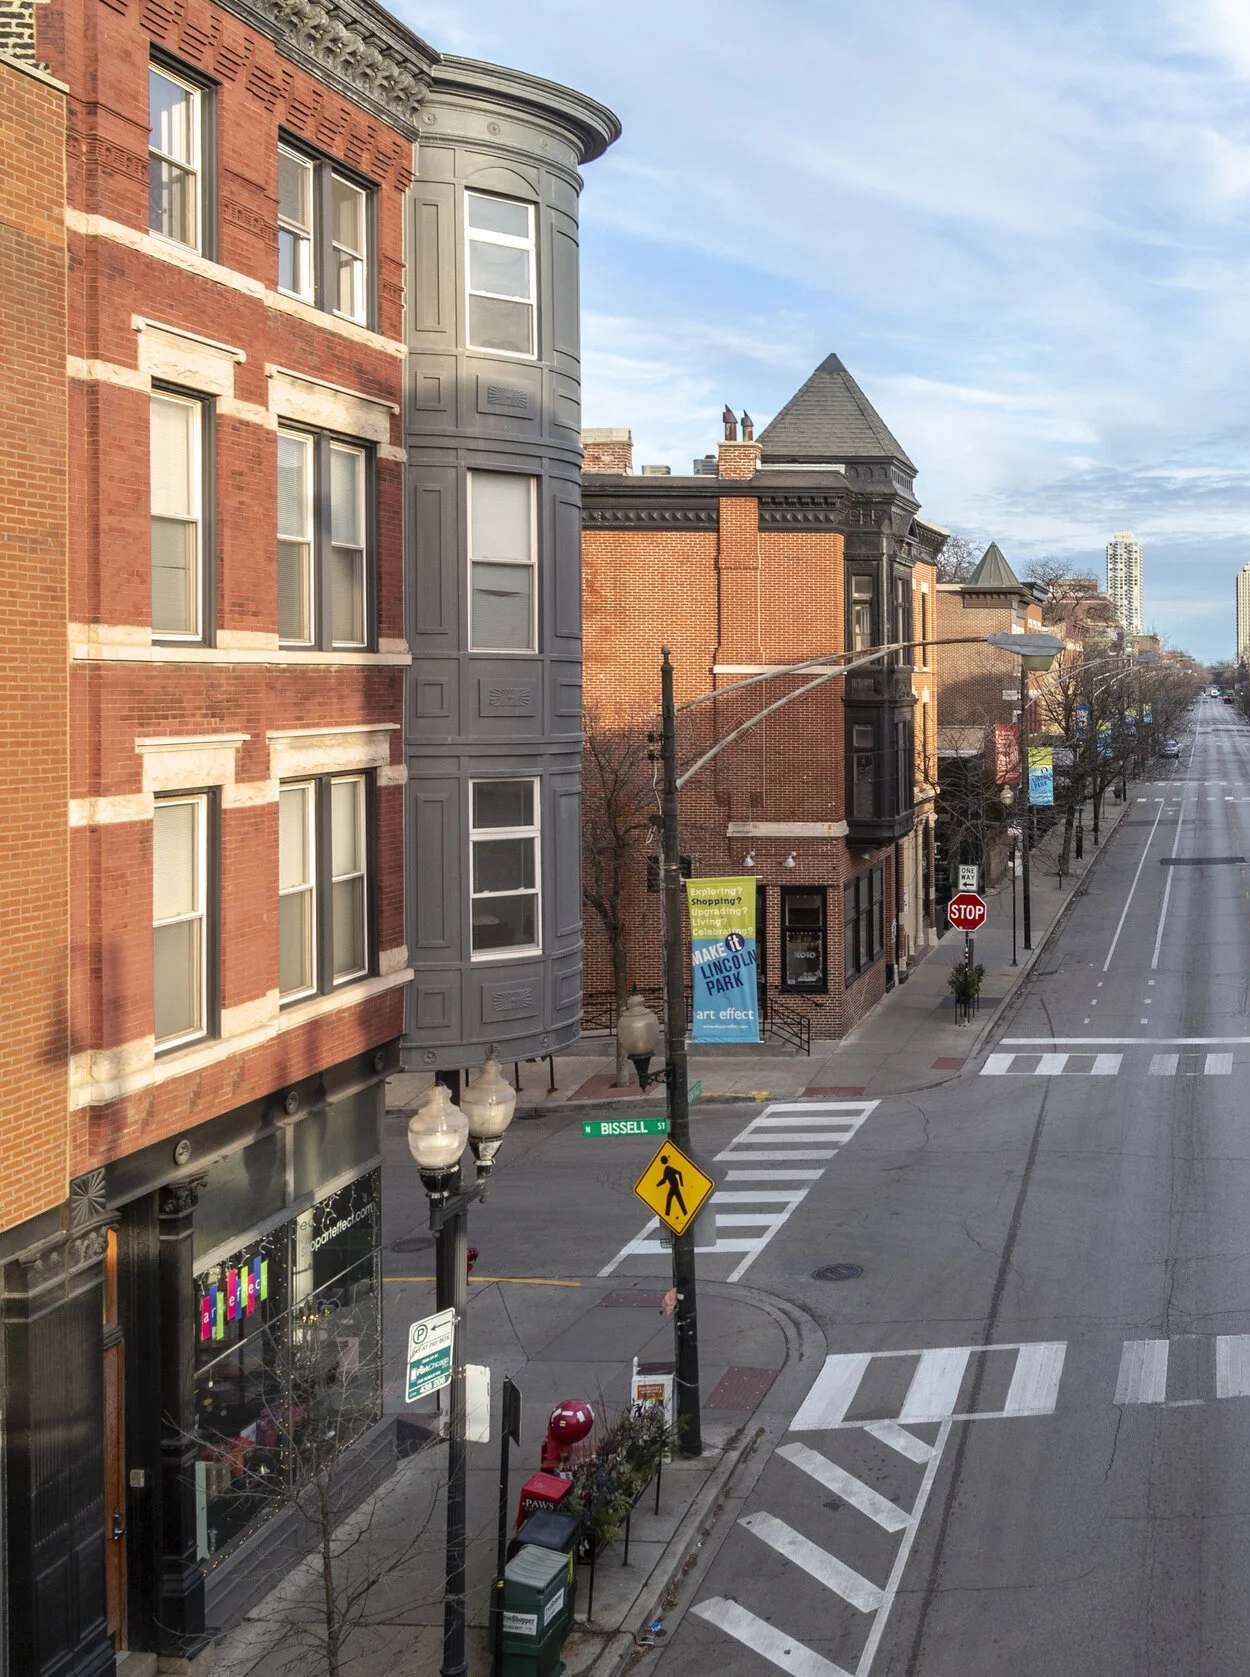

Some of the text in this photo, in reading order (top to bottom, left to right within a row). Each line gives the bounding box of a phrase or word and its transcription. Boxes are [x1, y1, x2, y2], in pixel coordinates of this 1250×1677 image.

[690, 886, 743, 896] Exploring?
[691, 897, 742, 906] Shopping?
[691, 907, 748, 916] Upgrading?
[950, 904, 984, 920] STOP
[692, 918, 727, 926] Living?
[692, 927, 753, 936] Celebrating?
[692, 934, 742, 966] MAKE it
[700, 949, 757, 979] LINCOLN
[706, 971, 744, 996] PARK
[696, 1007, 754, 1020] art effect
[601, 1121, 648, 1135] BISSELL
[657, 1122, 666, 1130] ST
[526, 1498, 554, 1510] PAWS
